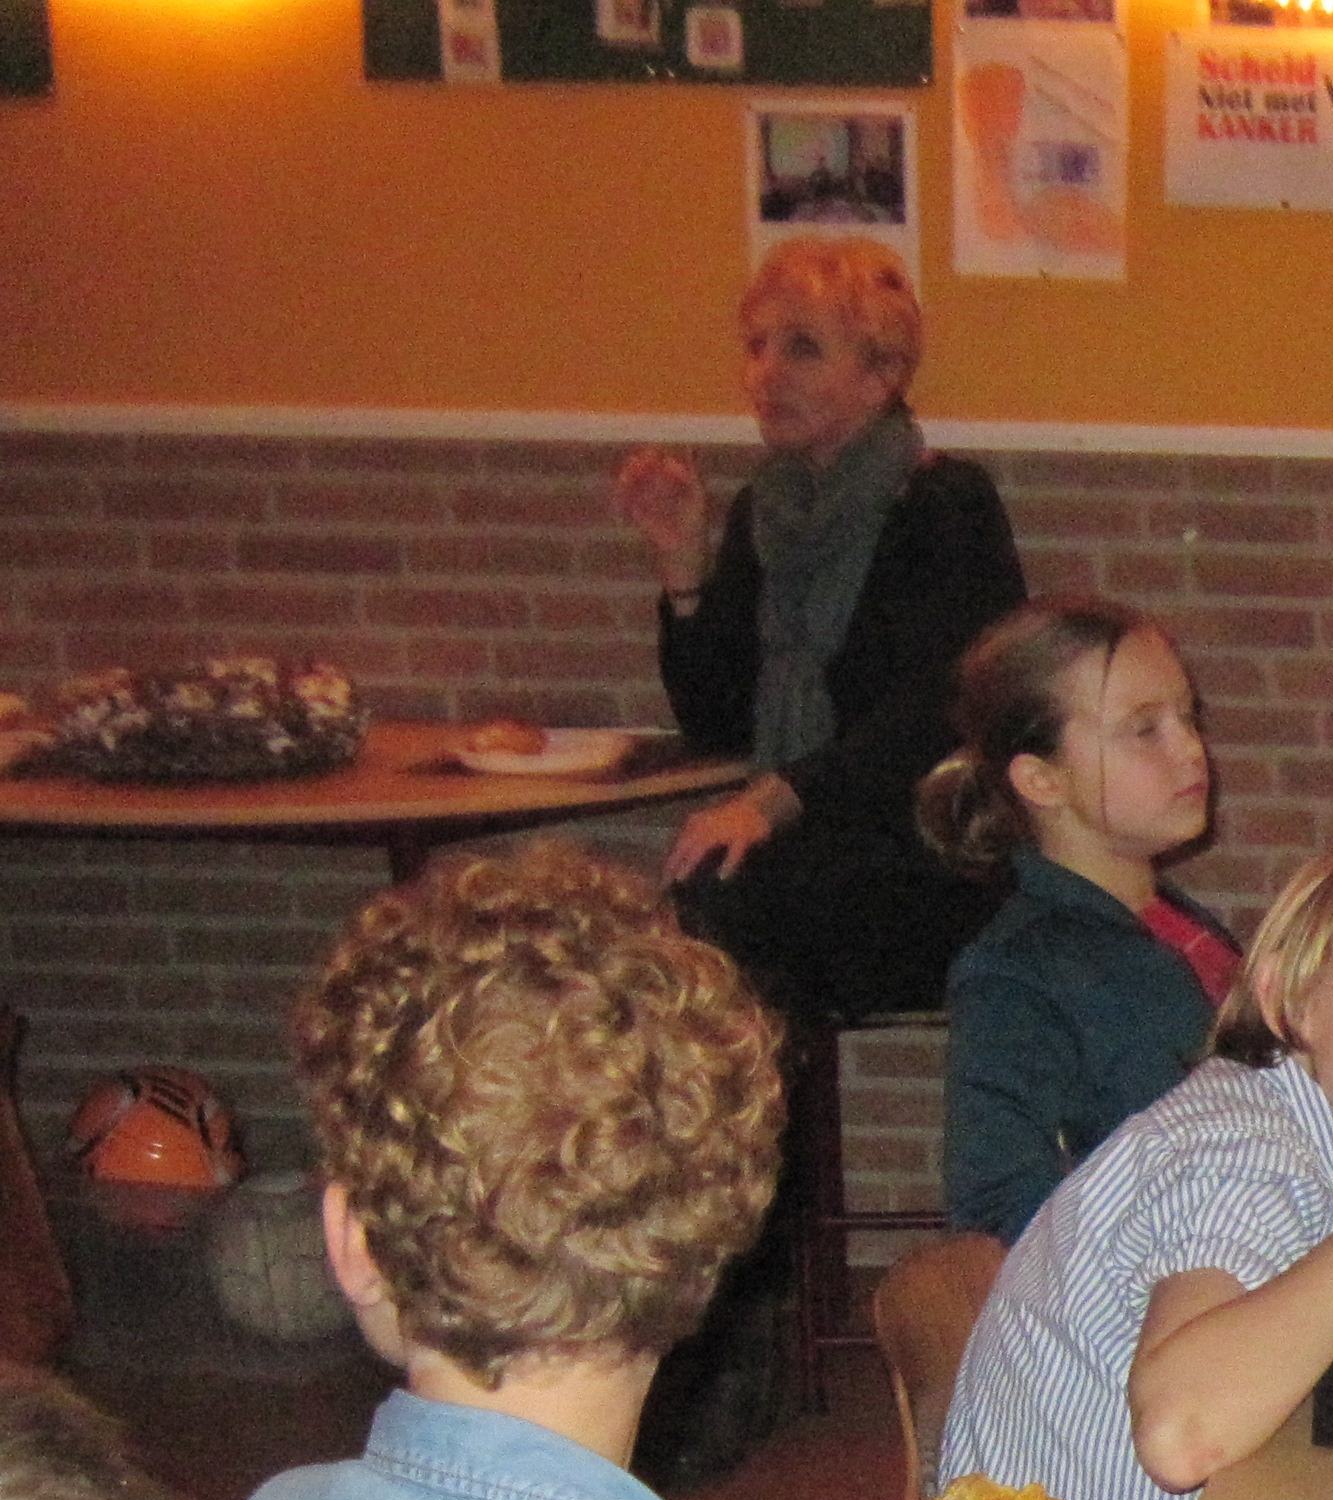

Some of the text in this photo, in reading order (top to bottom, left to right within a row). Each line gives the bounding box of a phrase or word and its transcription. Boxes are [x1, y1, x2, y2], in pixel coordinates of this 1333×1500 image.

[1198, 51, 1316, 85] Scheld
[1263, 90, 1316, 113] met
[1197, 113, 1317, 144] KANKER
